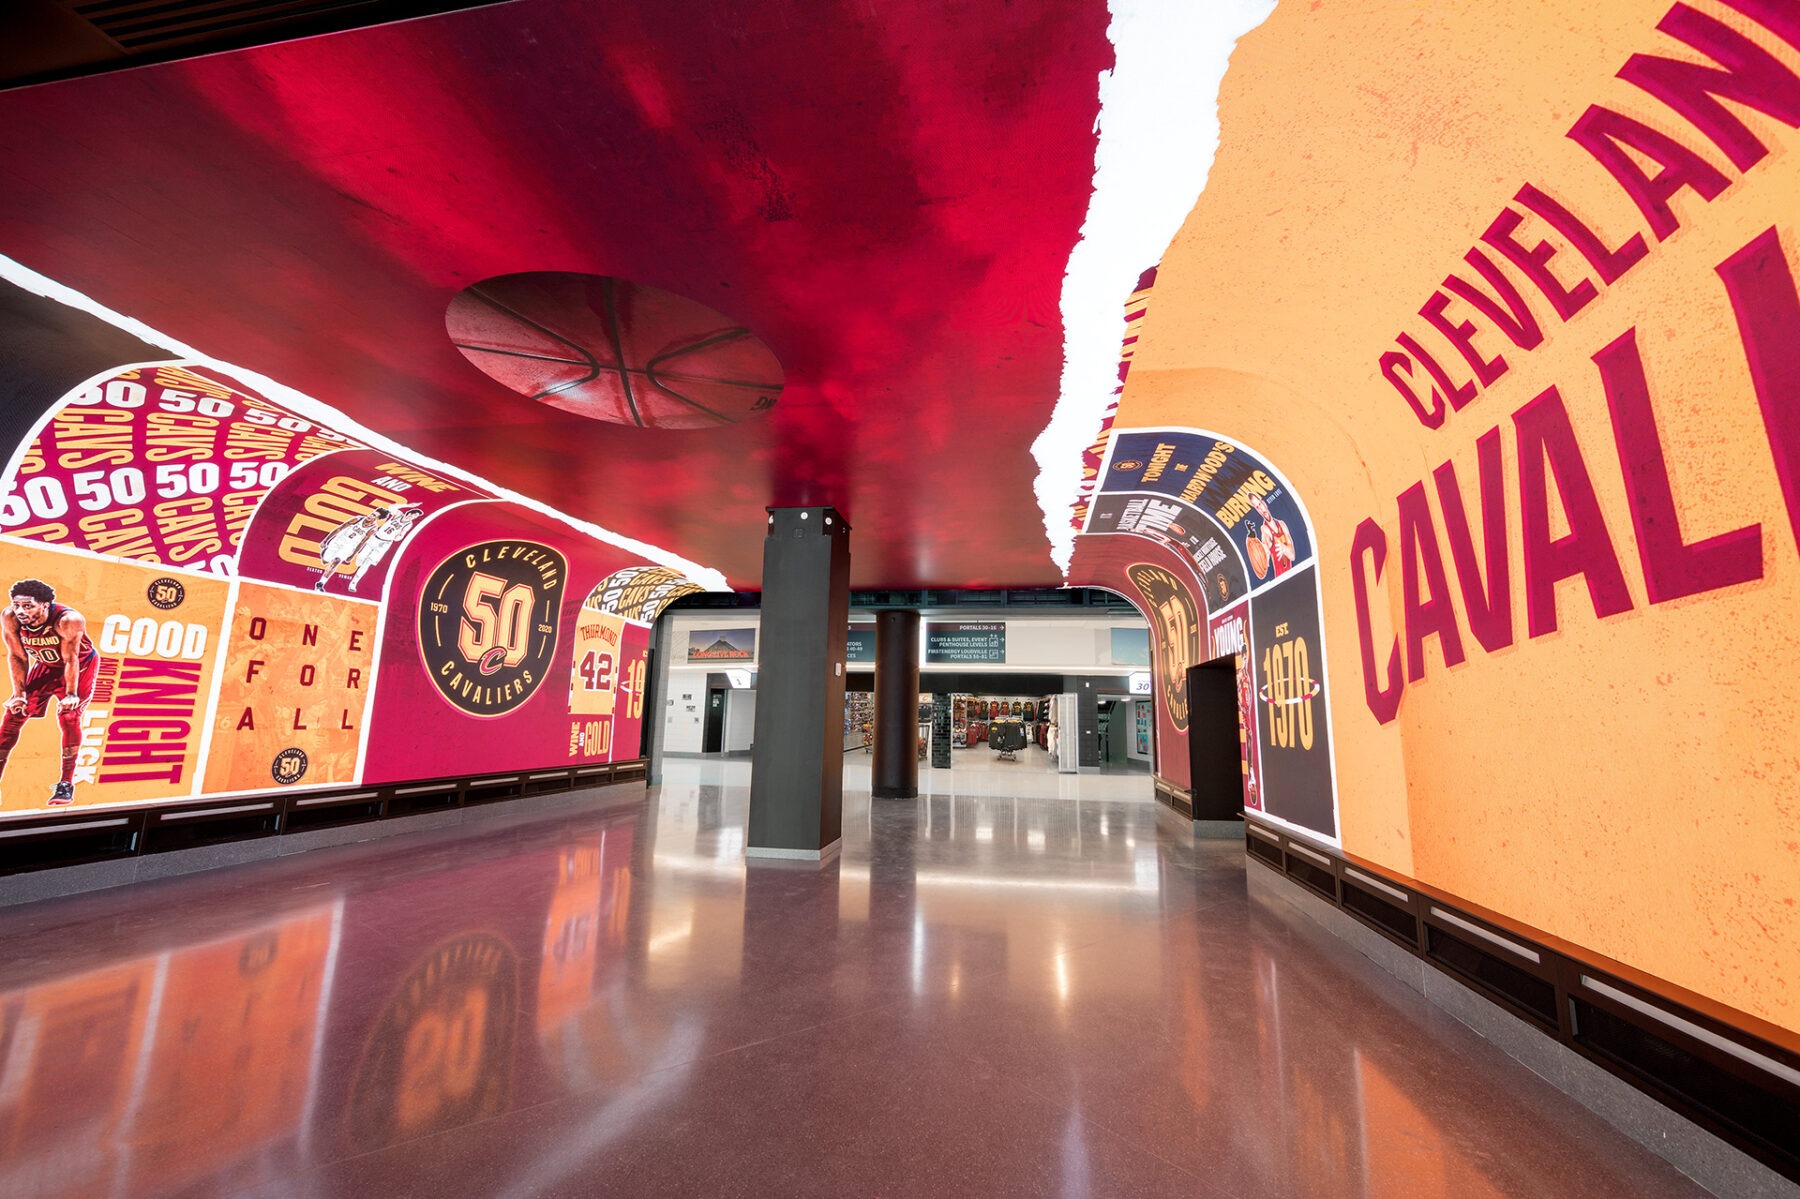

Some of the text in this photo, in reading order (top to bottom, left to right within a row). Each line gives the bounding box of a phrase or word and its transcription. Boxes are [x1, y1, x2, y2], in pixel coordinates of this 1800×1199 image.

[1378, 0, 1800, 430] CLEVELAN
[158, 388, 235, 418] 50
[243, 408, 312, 432] 50
[53, 408, 135, 469] CAVS
[145, 412, 220, 461] CAVS
[223, 421, 296, 460] CAVS
[156, 462, 220, 498] 50
[229, 461, 290, 490] 50
[1141, 443, 1176, 482] TONIGHT
[1179, 441, 1235, 504] HARDWOOD'S
[1350, 224, 1800, 725] CAVALI
[73, 467, 147, 511] 50
[370, 476, 413, 492] AND
[1215, 470, 1277, 530] BURNING
[153, 497, 222, 562] CAVS
[465, 546, 558, 590] CLEVELAND
[156, 585, 177, 603] 50
[430, 602, 449, 614] 1970
[618, 585, 656, 609] CAVS
[100, 614, 208, 660] GOOD
[249, 617, 364, 651] ONE
[458, 571, 535, 668] 50
[538, 624, 553, 634] 2020
[580, 624, 618, 647] THURMOND
[1214, 617, 1244, 658] YOUNG
[22, 636, 60, 646] EVELAND
[98, 656, 119, 677] AND
[246, 660, 361, 689] FOR
[441, 660, 533, 705] CAVALIERS
[580, 650, 613, 692] 42
[626, 659, 646, 719] 19
[1263, 636, 1314, 751] 1970
[98, 657, 203, 784] KNIGHT
[236, 707, 354, 730] ALL
[73, 709, 109, 785] LUCK
[569, 721, 580, 757] WINE
[584, 720, 610, 757] GOLD
[280, 757, 300, 775] 50
